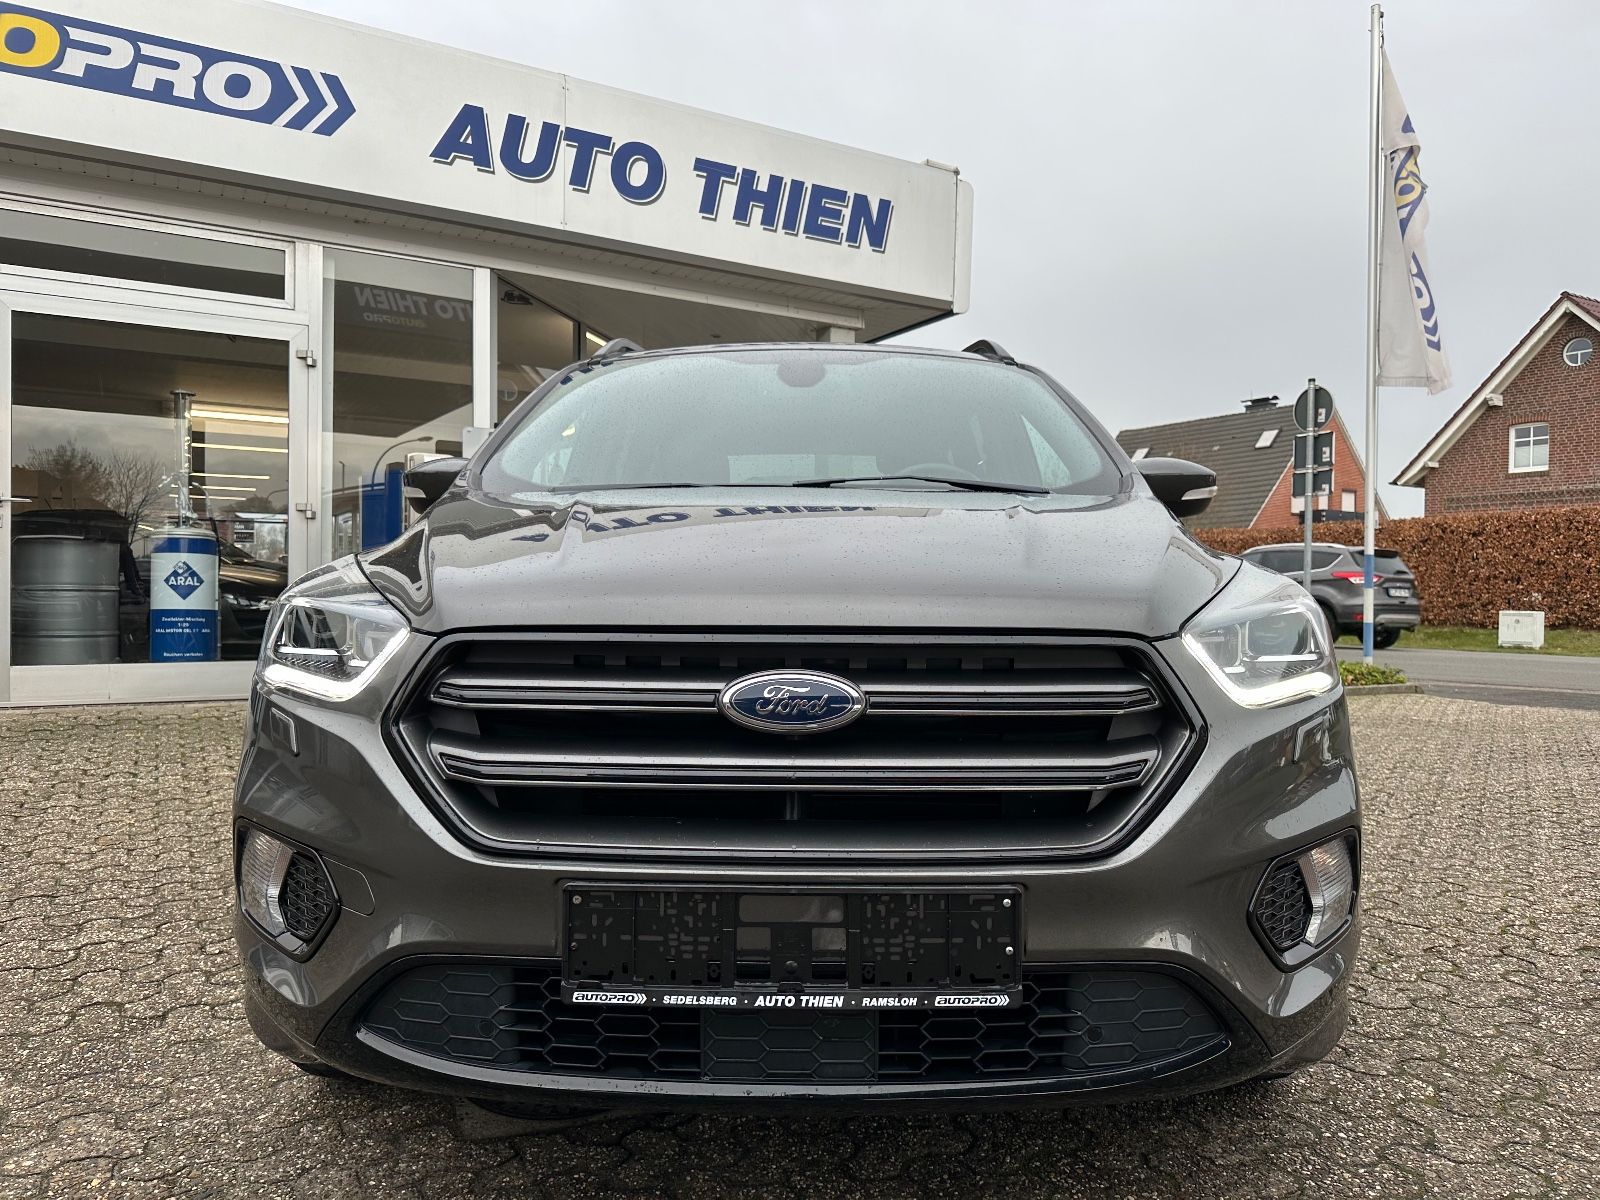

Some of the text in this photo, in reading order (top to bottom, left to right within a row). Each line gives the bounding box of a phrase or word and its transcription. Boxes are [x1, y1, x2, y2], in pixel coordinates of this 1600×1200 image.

[429, 102, 894, 252] AUTO THIEN
[168, 576, 200, 586] ARAL
[755, 685, 829, 716] Ford
[662, 995, 737, 1006] SEDELSBERG
[754, 995, 796, 1007] AUTO
[800, 995, 844, 1008] THIEN
[862, 997, 918, 1007] RAMSLOH
